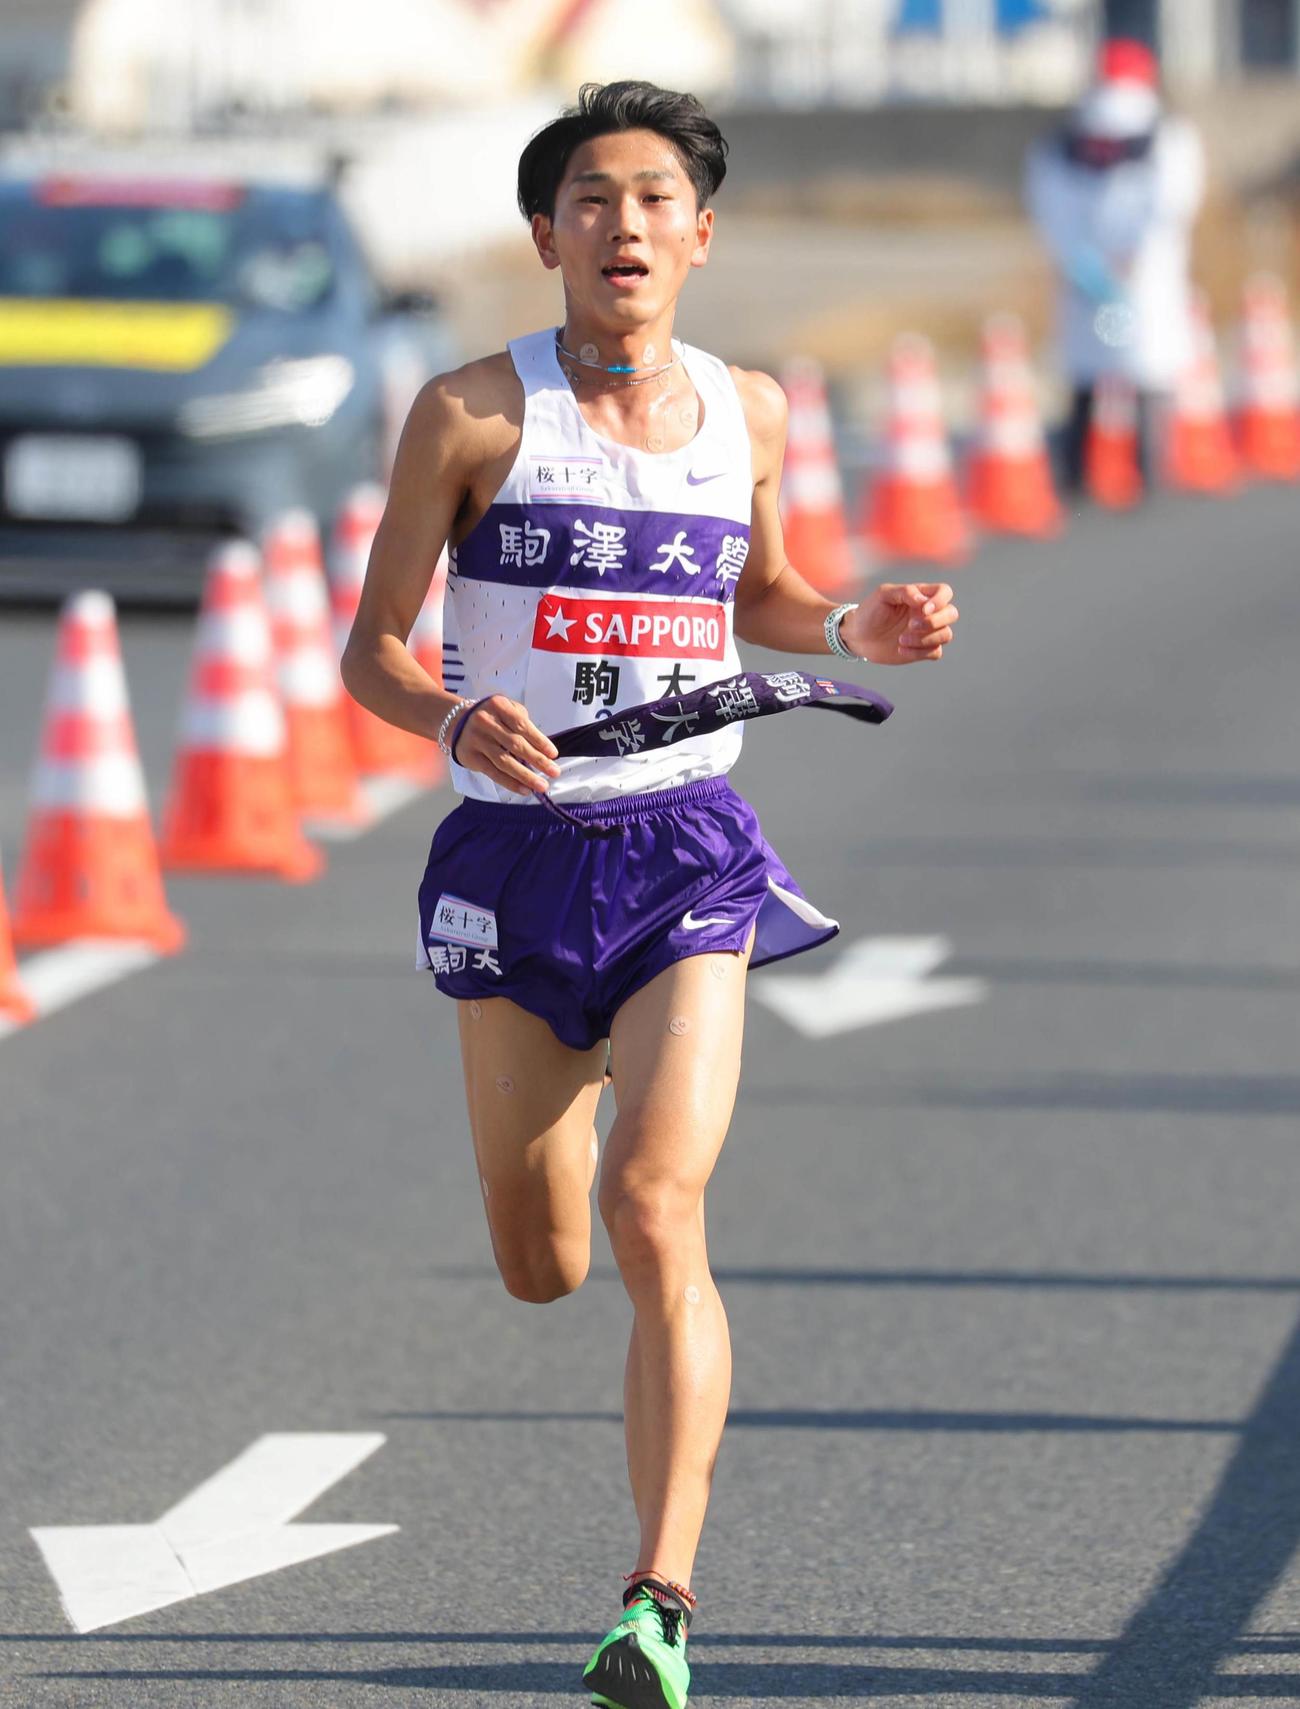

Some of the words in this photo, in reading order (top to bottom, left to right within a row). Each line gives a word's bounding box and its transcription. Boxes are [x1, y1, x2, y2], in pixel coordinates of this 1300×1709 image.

[536, 465, 598, 485] 桜十字
[584, 612, 719, 650] SAPPORO
[599, 671, 810, 757] 駒澤大学
[440, 905, 493, 934] 桜十字
[428, 944, 503, 976] 駒大
